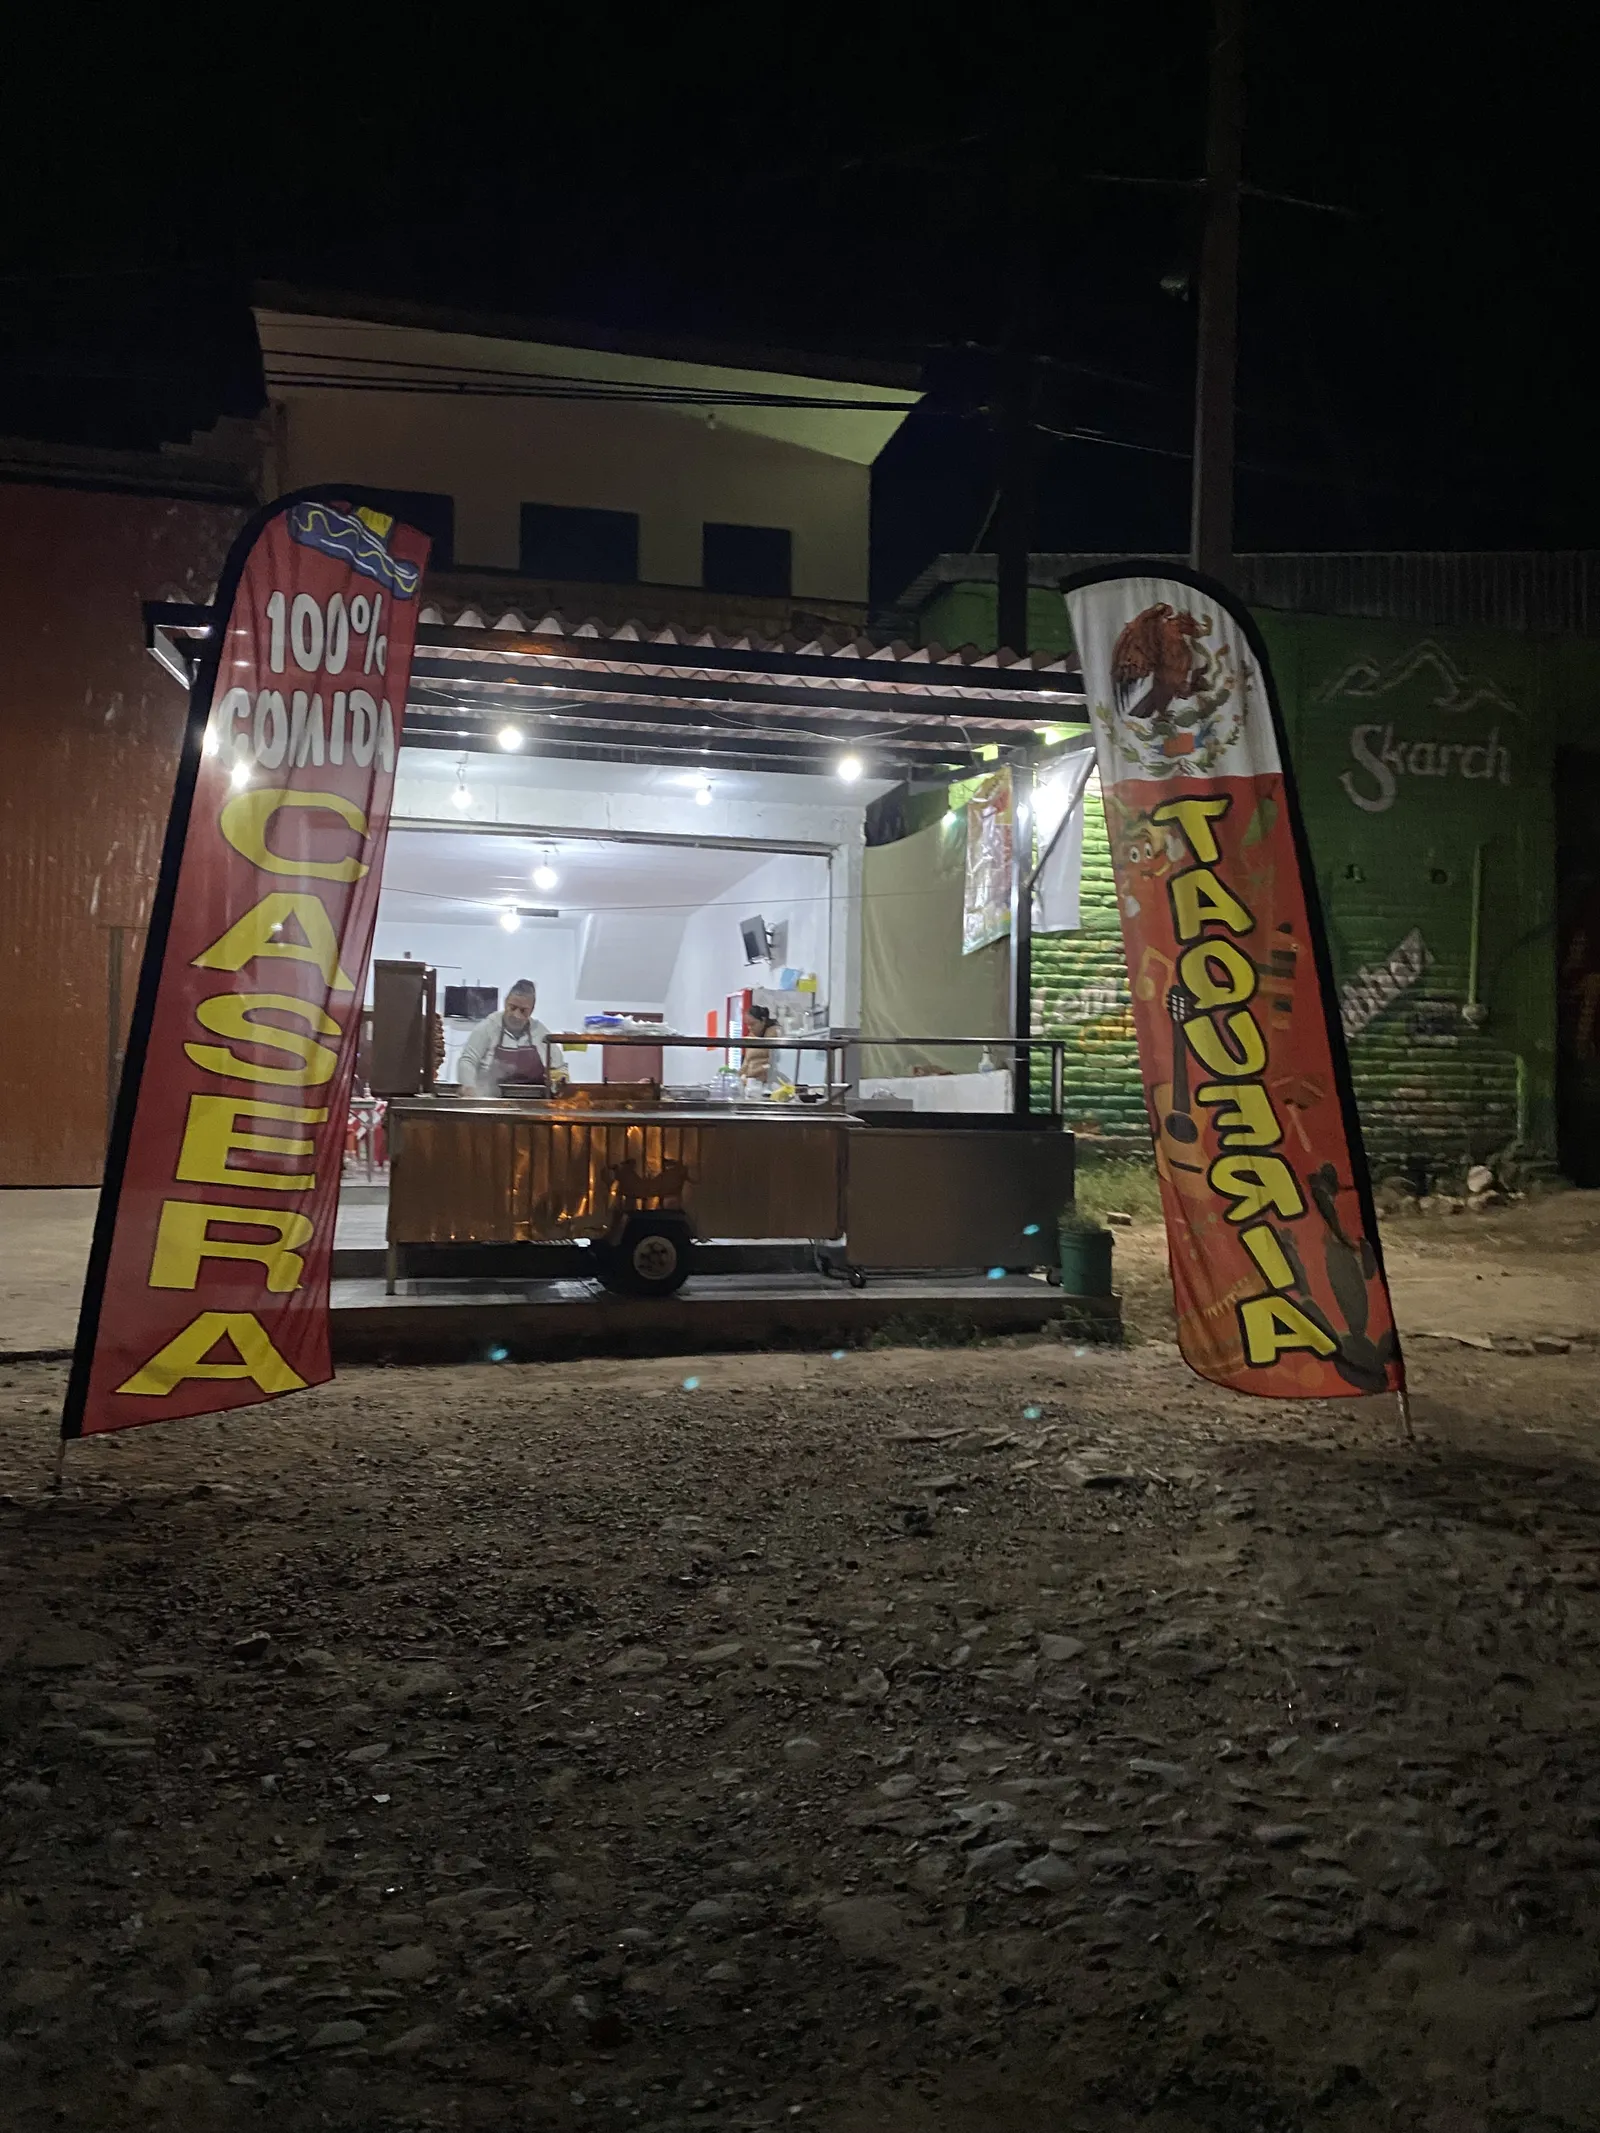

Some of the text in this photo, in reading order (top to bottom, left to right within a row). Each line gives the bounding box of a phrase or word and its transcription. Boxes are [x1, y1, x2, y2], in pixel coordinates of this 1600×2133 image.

[265, 590, 388, 676] 100%
[218, 687, 395, 774] COMIDA
[114, 788, 370, 1396] CASERA
